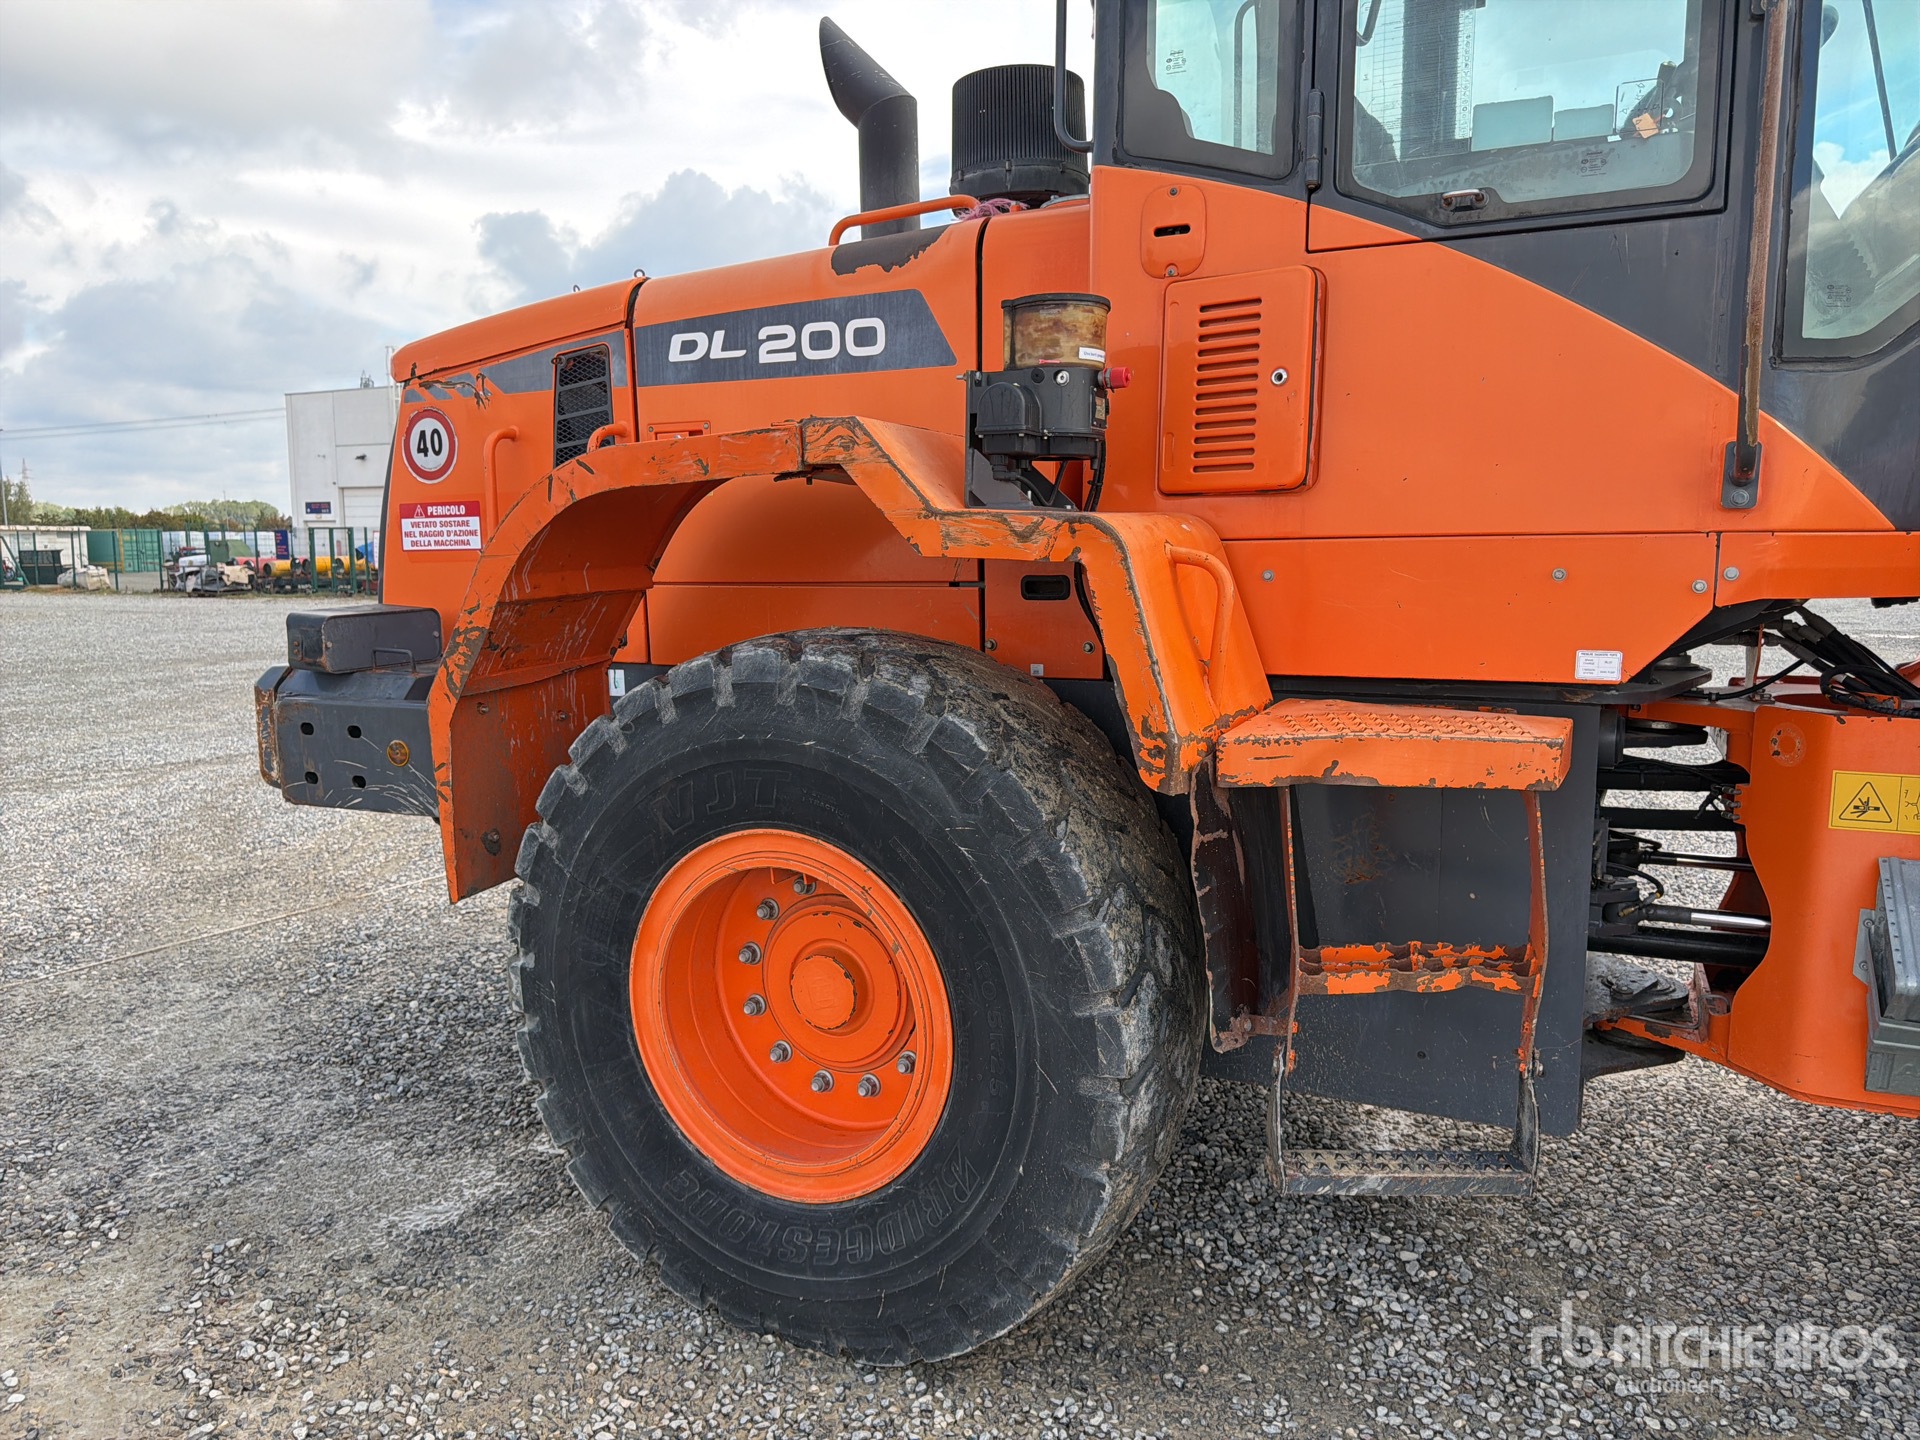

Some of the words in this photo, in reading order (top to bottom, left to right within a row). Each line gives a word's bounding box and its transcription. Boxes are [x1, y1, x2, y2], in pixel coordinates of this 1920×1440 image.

[668, 330, 747, 363] DL
[757, 317, 886, 364] 200
[416, 428, 443, 457] 40
[427, 505, 466, 516] PERICOLO
[410, 520, 438, 529] VIETATO
[439, 519, 471, 528] SOSTARE
[404, 530, 417, 539] NEL
[418, 530, 445, 538] RAGGIO
[446, 529, 479, 537] D'AZIONE
[410, 540, 432, 548] DELLA
[433, 538, 472, 547] MACCHINA
